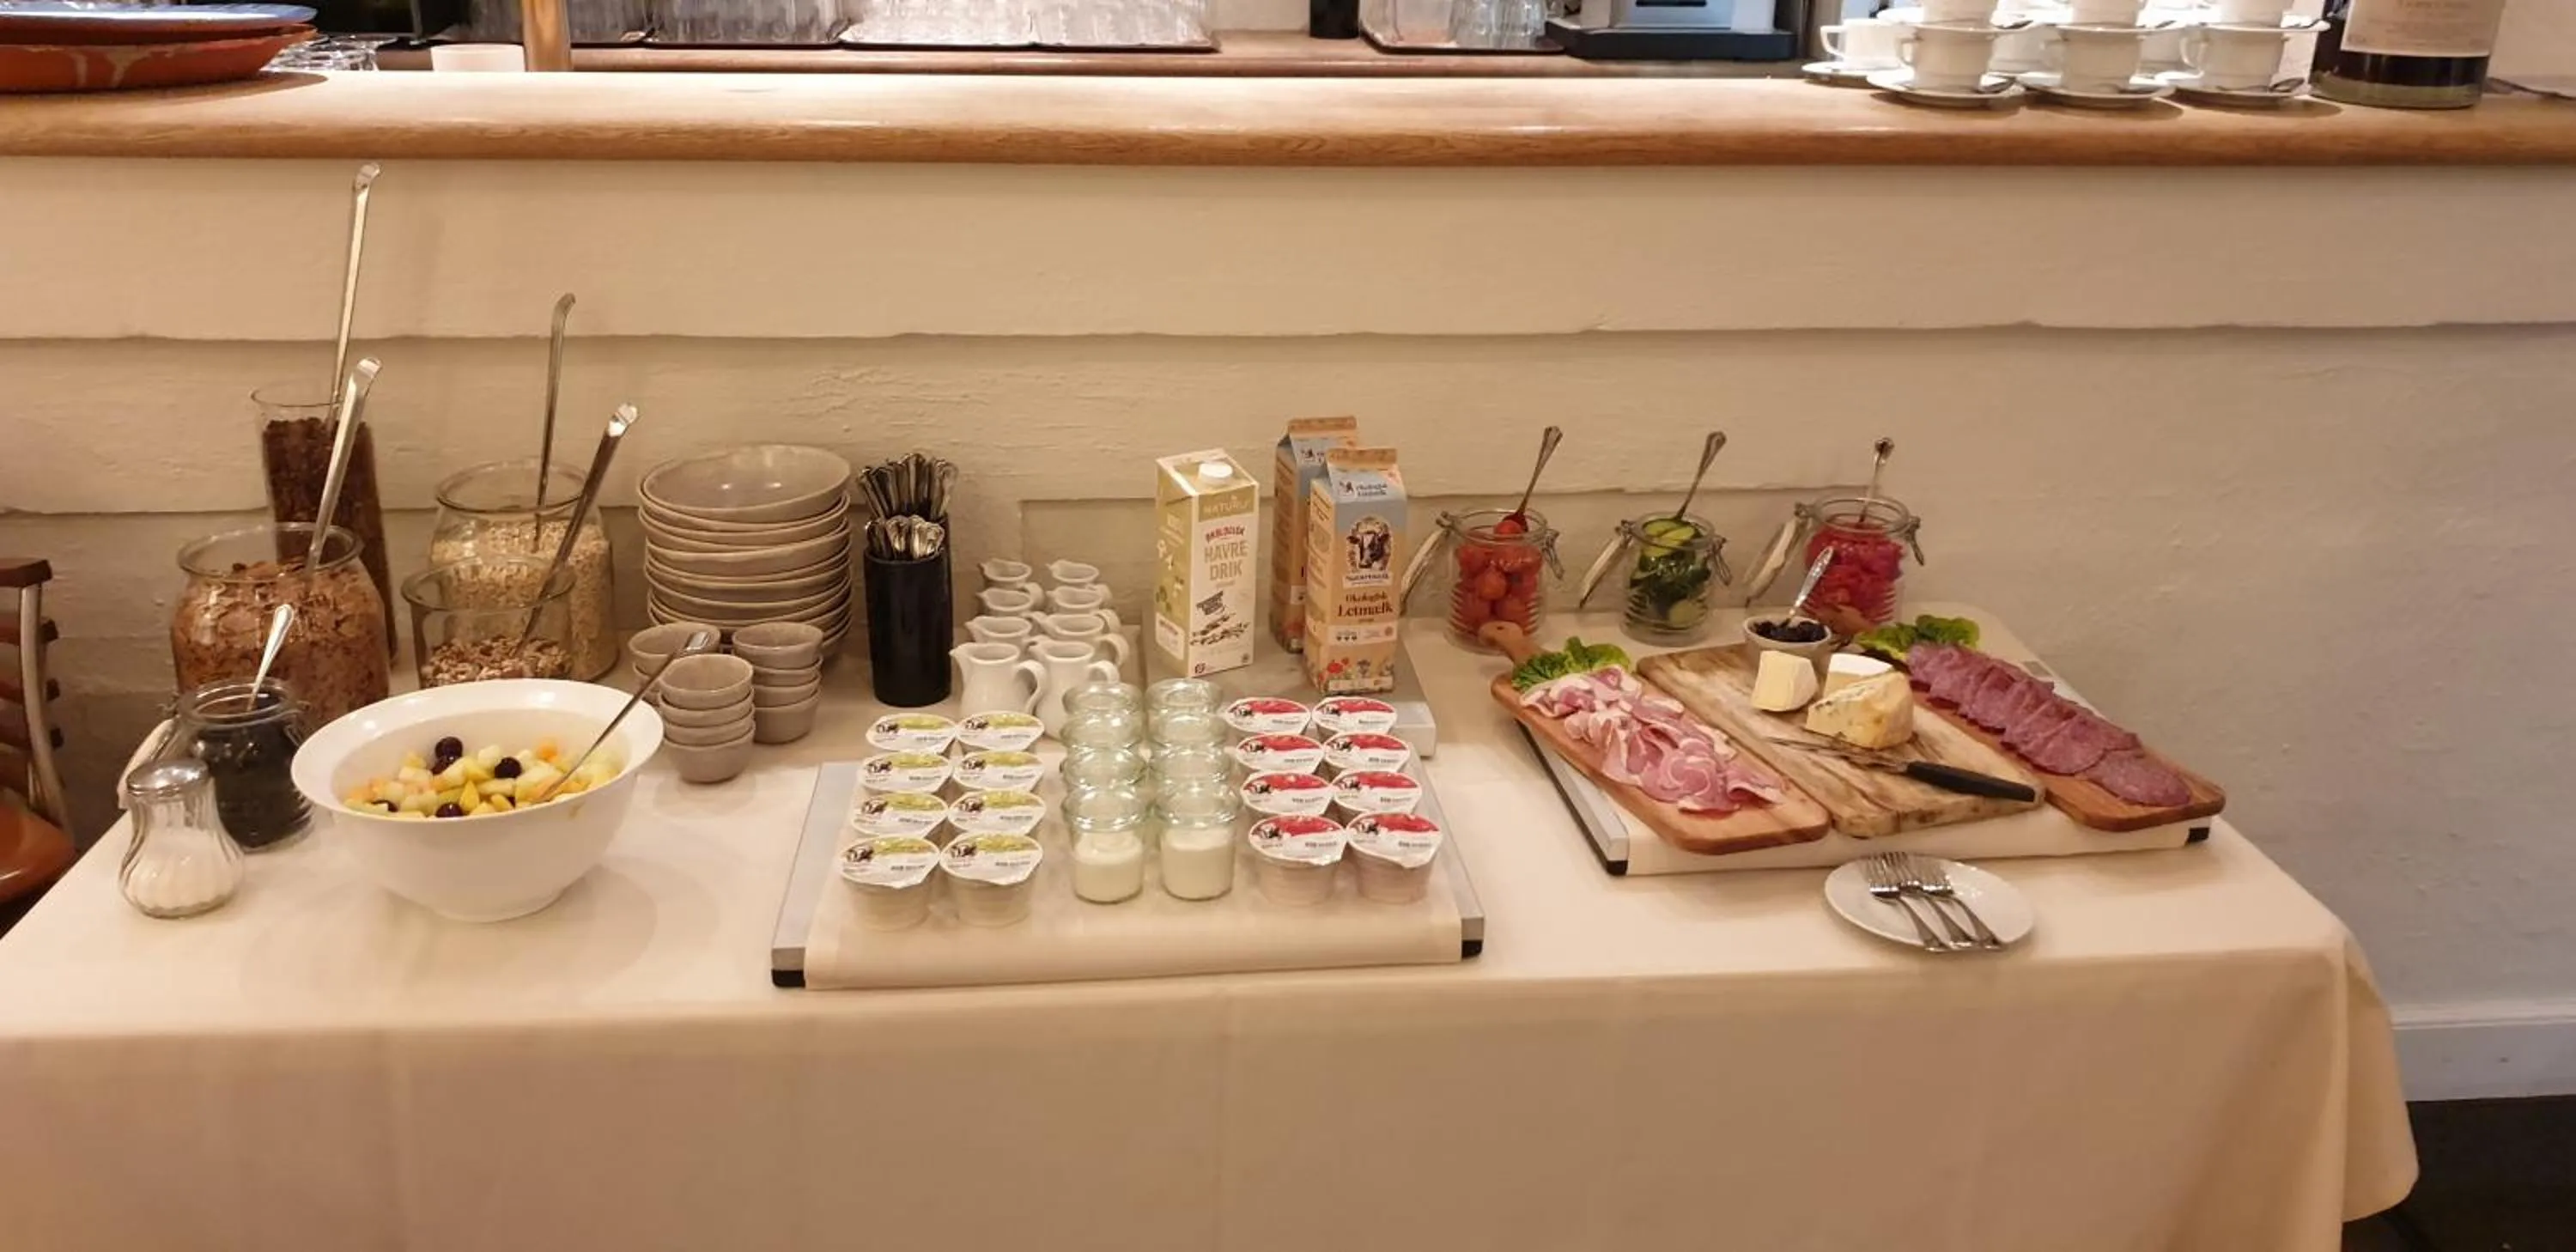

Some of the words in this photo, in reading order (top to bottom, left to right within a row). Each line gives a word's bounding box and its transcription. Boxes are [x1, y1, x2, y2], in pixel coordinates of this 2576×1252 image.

[1204, 540, 1249, 563] HAVRE
[1209, 560, 1242, 580] DRIK
[1337, 601, 1394, 617] Letmælk
